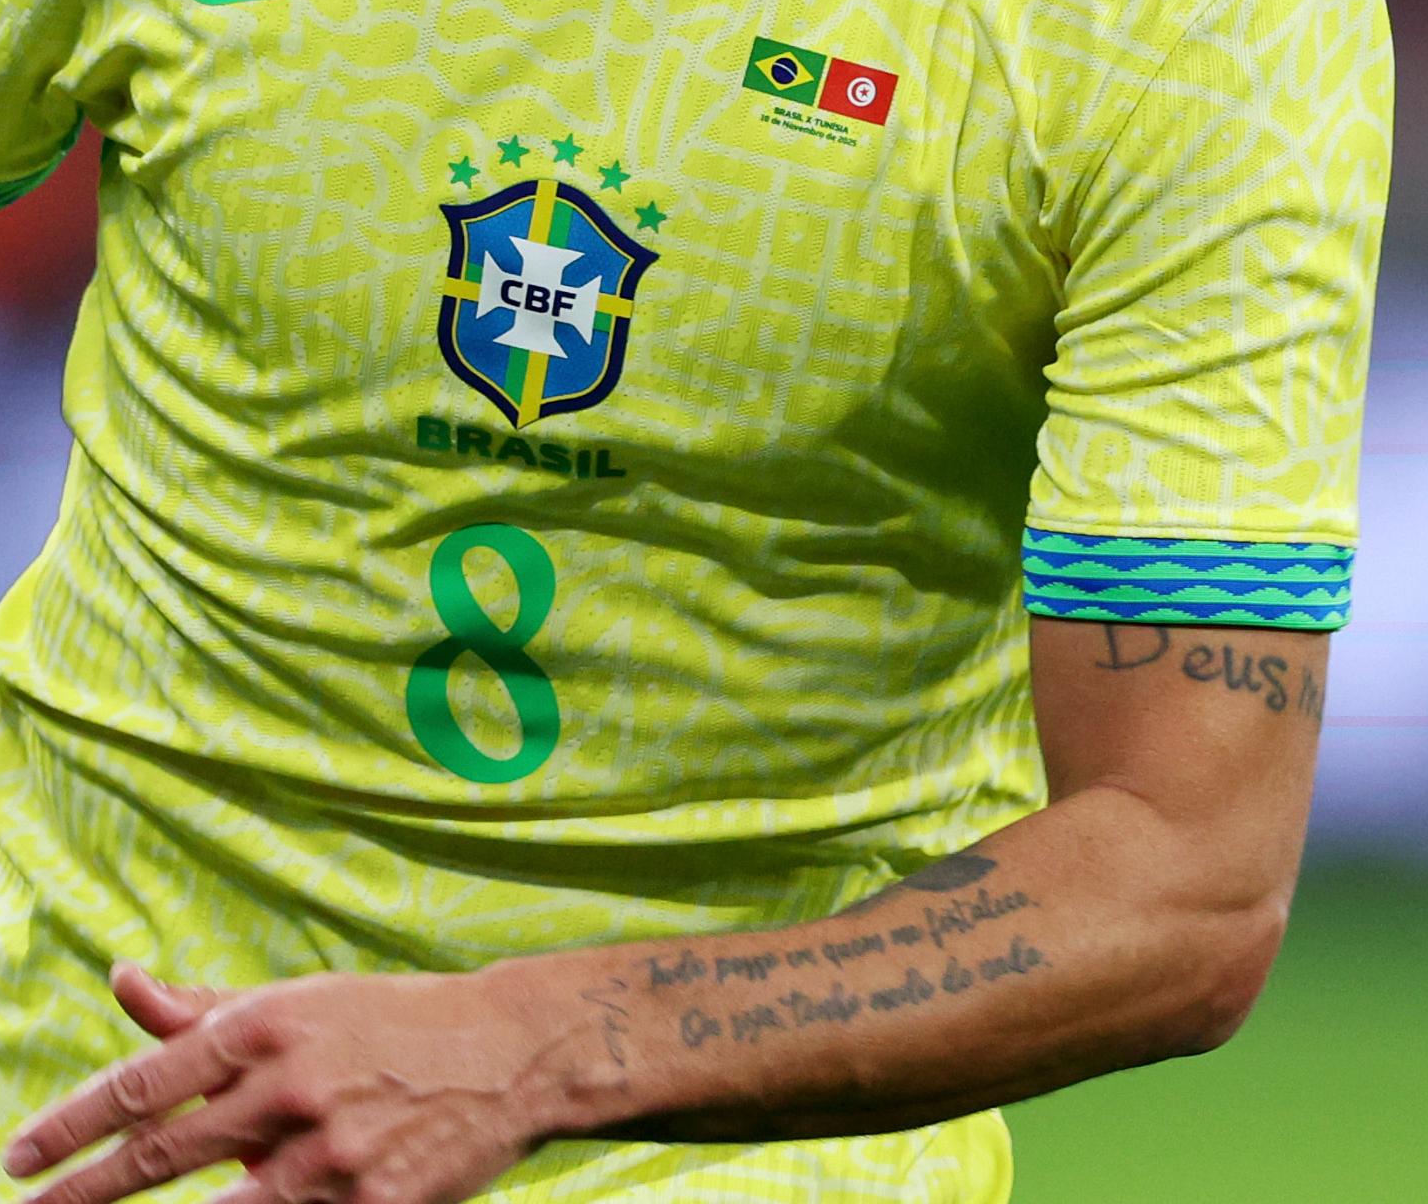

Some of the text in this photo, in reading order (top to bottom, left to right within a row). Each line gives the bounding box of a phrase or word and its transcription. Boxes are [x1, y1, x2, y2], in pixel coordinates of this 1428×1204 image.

[774, 107, 803, 122] BRASIL
[500, 279, 577, 317] CBF
[416, 415, 626, 479] BRASIL
[405, 522, 561, 784] 8
[1095, 625, 1288, 712] Deus
